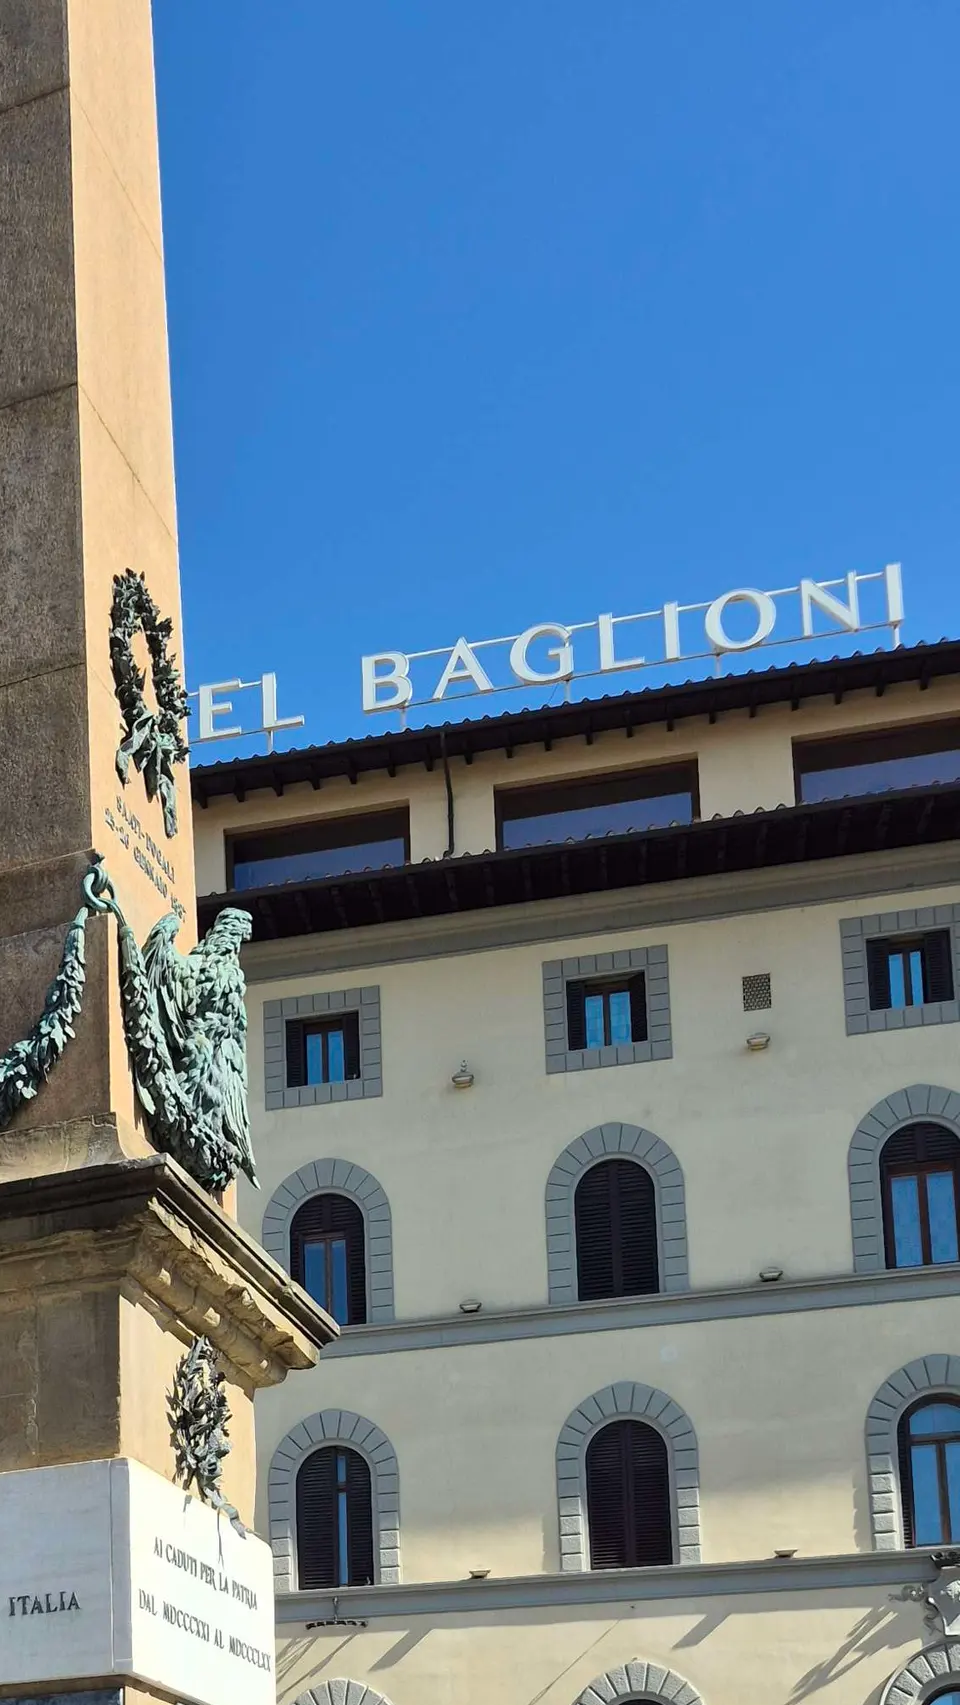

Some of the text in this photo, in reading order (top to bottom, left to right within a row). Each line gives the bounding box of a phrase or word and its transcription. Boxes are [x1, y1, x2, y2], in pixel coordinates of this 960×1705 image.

[361, 563, 905, 714] BAGLIONI
[8, 1591, 81, 1618] ITALIA
[153, 1536, 258, 1611] AI CADUTI PER LA PATRIA
[139, 1588, 158, 1616] DAL
[162, 1600, 210, 1642] MDCCCXXI
[214, 1628, 224, 1650] AL
